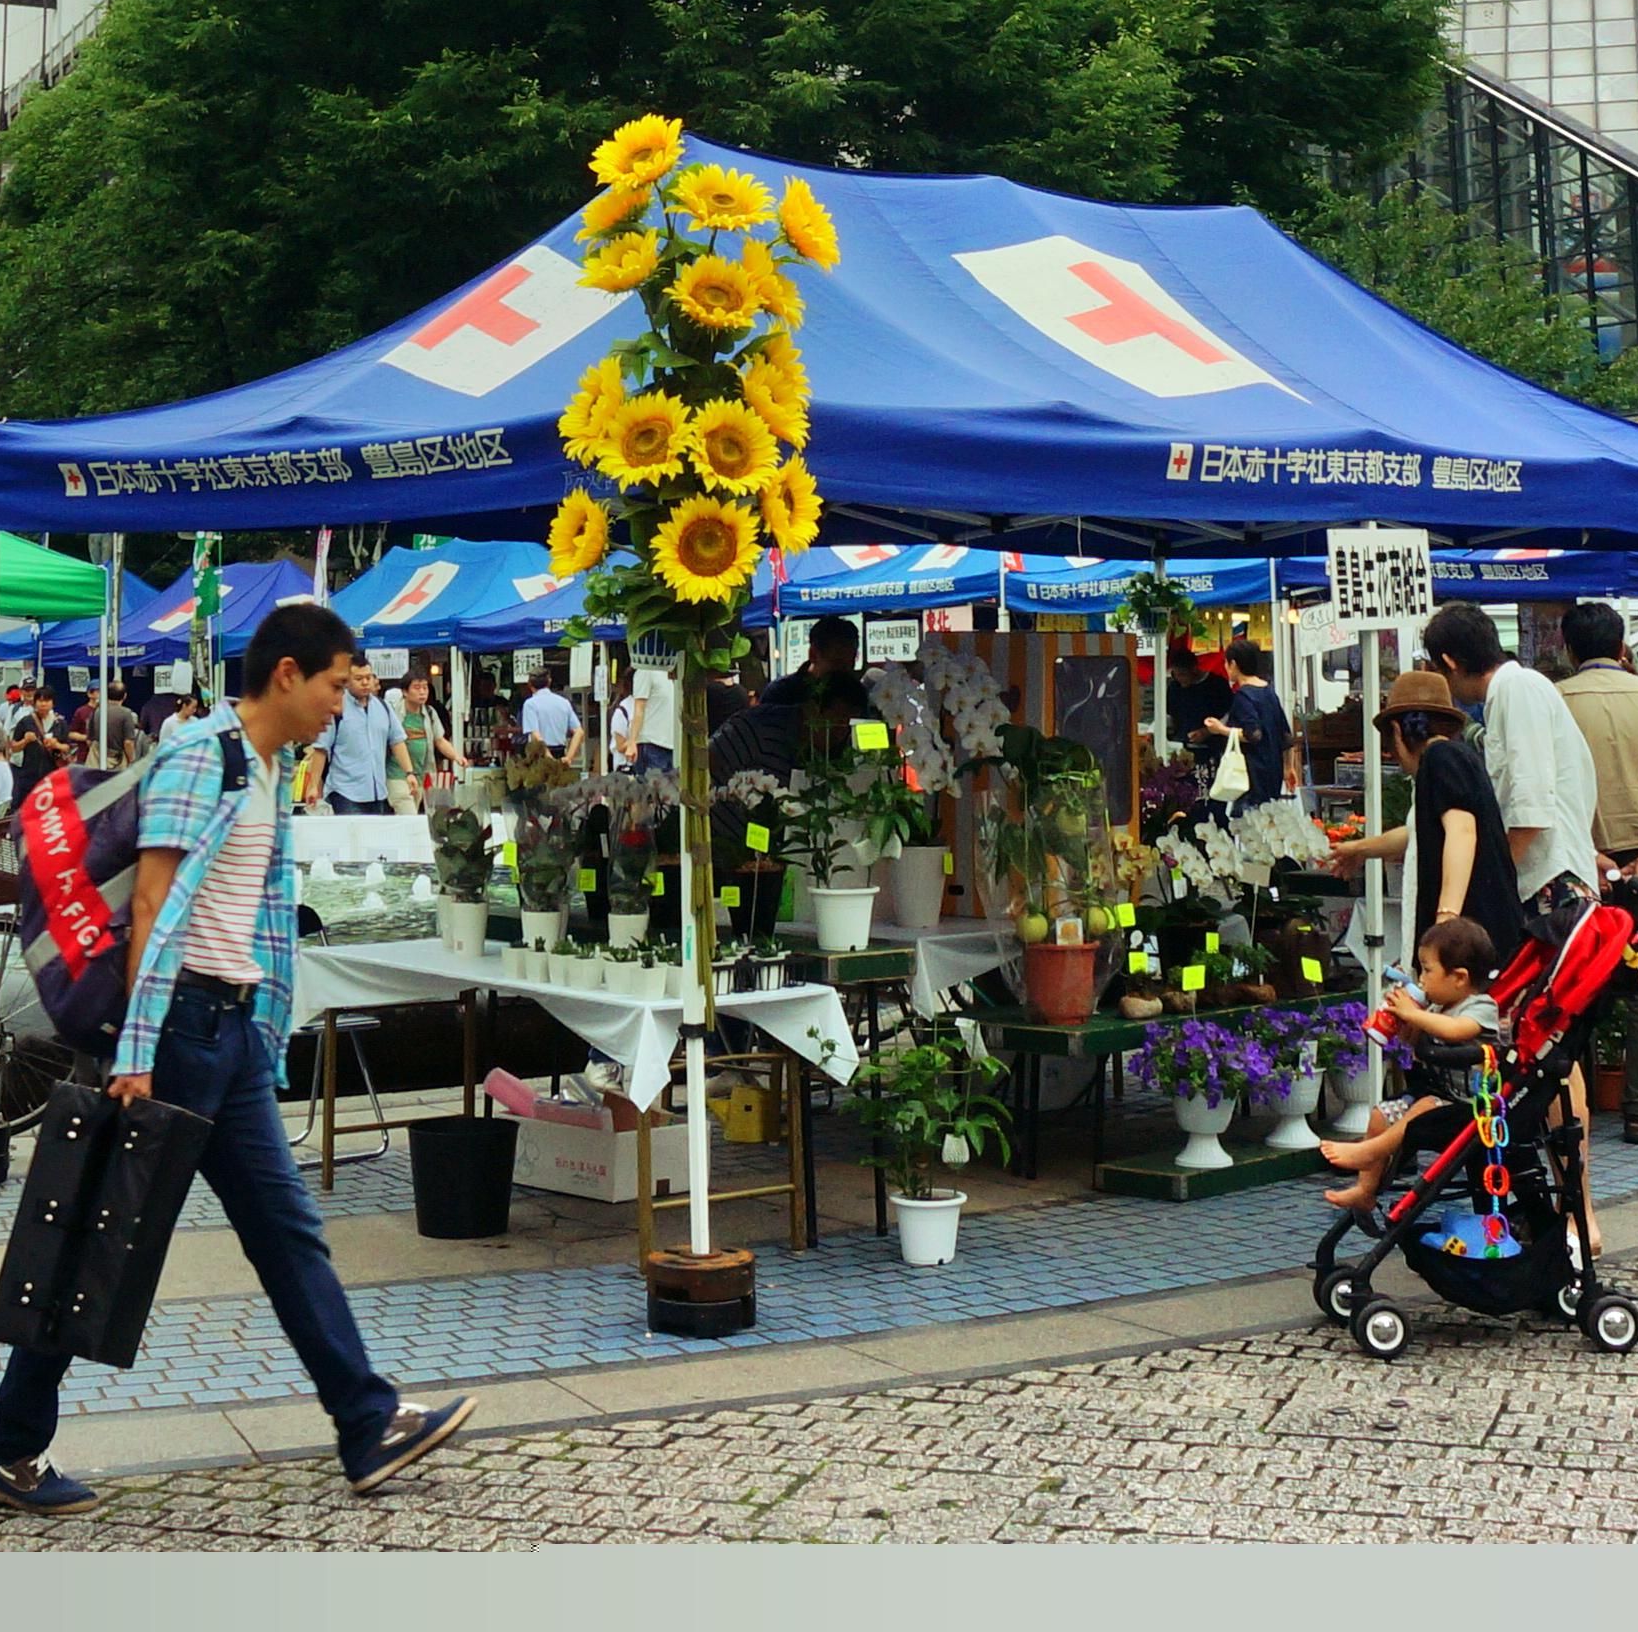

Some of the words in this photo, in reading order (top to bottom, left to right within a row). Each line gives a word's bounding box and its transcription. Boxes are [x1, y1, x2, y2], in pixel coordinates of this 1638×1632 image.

[87, 445, 353, 498] 日本赤十字社東京都支部
[359, 427, 513, 480] 豊島区地区
[1199, 444, 1423, 488] 日本赤十字社東京都支部
[1431, 455, 1523, 493] 豊島区地区
[35, 776, 71, 856] TOMMY
